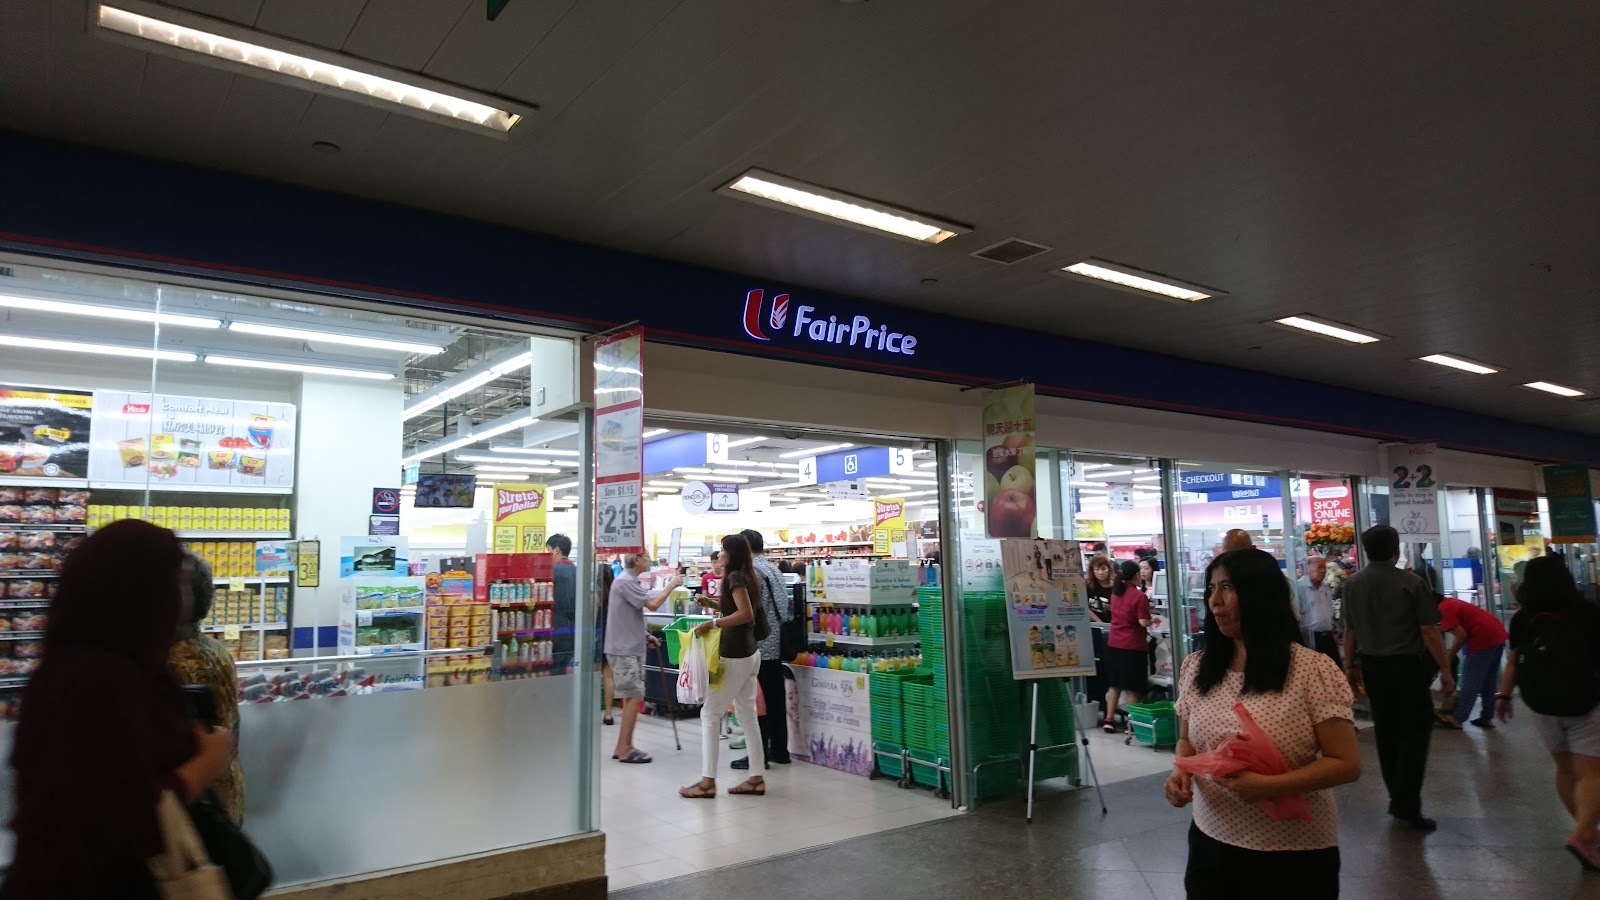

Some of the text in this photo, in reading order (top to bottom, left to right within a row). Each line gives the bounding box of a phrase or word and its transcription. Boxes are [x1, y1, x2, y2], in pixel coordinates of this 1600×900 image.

[793, 304, 918, 356] FairPrice
[125, 404, 147, 414] Yeo's
[162, 403, 204, 414] Comfort
[205, 405, 229, 416] Meal
[712, 433, 720, 454] 6
[896, 447, 905, 466] 5
[803, 462, 812, 480] 4
[498, 489, 539, 505] Stretch
[604, 484, 634, 496] Save $1.15
[497, 499, 540, 518] your Dollar!
[1313, 500, 1341, 511] SHOP
[1393, 499, 1411, 507] good
[1223, 504, 1262, 522] DELI
[1314, 508, 1351, 519] ONLINE
[383, 673, 426, 684] FairPrice
